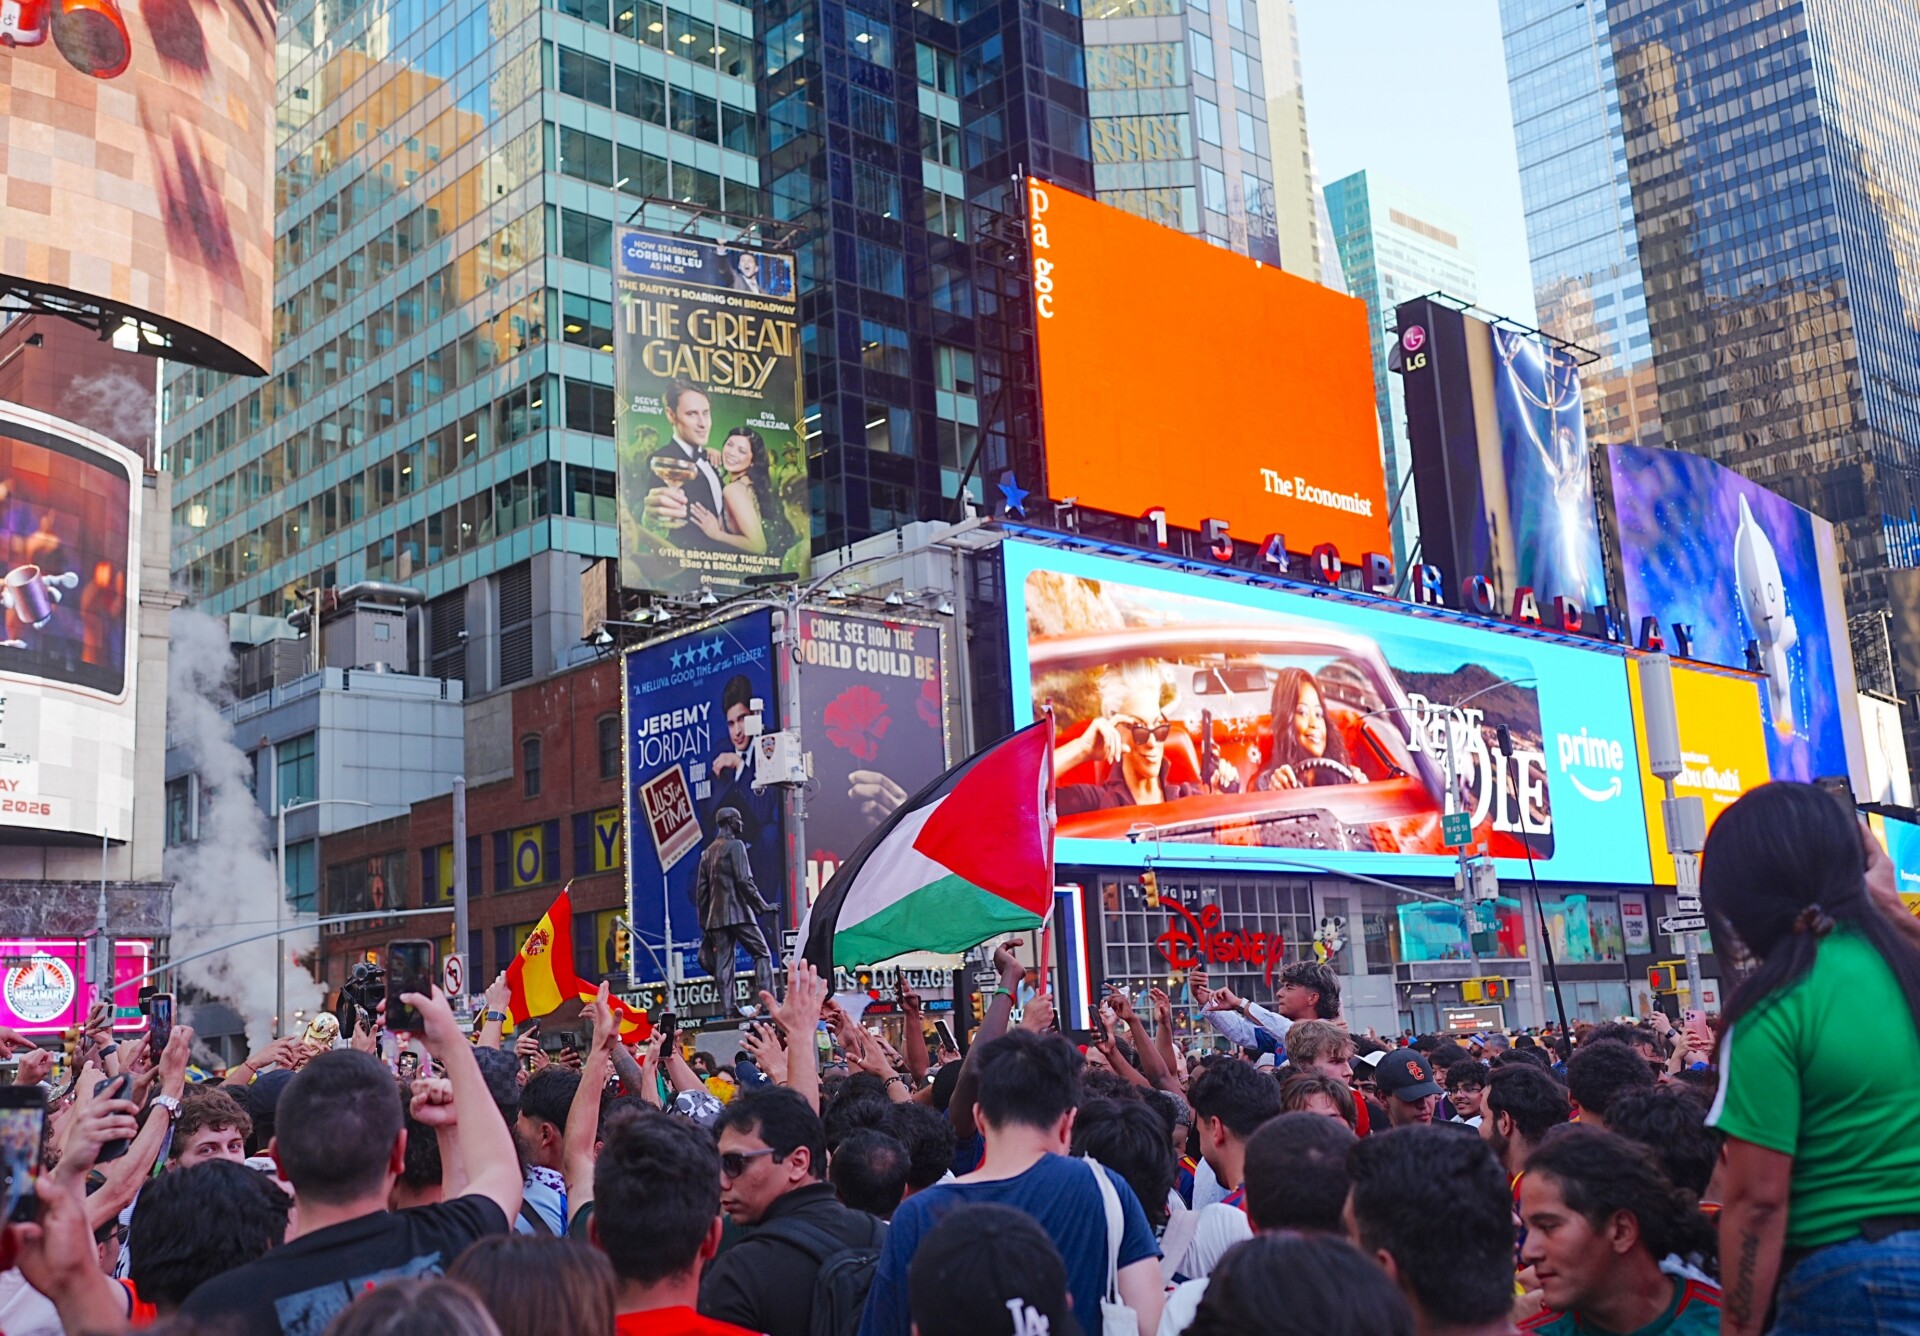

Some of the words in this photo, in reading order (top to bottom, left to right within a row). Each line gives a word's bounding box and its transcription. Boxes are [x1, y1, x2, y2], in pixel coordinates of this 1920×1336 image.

[634, 240, 656, 251] NOW
[657, 243, 699, 258] STARRING
[1030, 177, 1054, 318] pagc
[627, 248, 673, 266] CORBIN
[674, 255, 703, 269] BLEU
[650, 262, 661, 271] AS
[662, 263, 685, 275] NICK
[618, 279, 638, 291] THE
[639, 282, 680, 298] PARTY'S
[681, 288, 726, 305] ROARING
[727, 295, 743, 306] ON
[743, 299, 796, 316] BROADWAY
[622, 296, 680, 341] THE
[687, 308, 796, 357] GREAT
[642, 339, 778, 390] GATSBY
[1406, 352, 1427, 371] LG
[634, 396, 659, 407] REEVE
[707, 385, 713, 393] A
[714, 386, 731, 395] NEW
[732, 388, 763, 399] MUSICAL
[631, 404, 663, 416] CARNEY
[760, 411, 775, 421] EVA
[746, 418, 790, 431] NOBLEZADA
[1260, 467, 1293, 497] The
[1294, 476, 1373, 517] Economist
[687, 549, 738, 563] BROADWAY
[740, 554, 780, 567] THEATRE
[703, 560, 711, 570] &
[712, 562, 763, 574] BROADWAY
[1140, 506, 1342, 583] 1540
[1362, 552, 1697, 657] BROADWAY
[810, 618, 841, 642] COME
[844, 622, 865, 645] SEE
[868, 626, 891, 648] HOW
[893, 629, 915, 651] THE
[856, 647, 911, 678] COULD
[914, 655, 935, 681] BE
[641, 677, 670, 694] HELLUVA
[670, 671, 695, 684] GOOD
[696, 664, 712, 677] TIME
[638, 701, 711, 738] JEREMY
[638, 723, 711, 770] JORDAN
[1557, 726, 1624, 773] prime
[1702, 766, 1741, 792] dhabi
[650, 782, 675, 817] JUST
[1440, 745, 1552, 834] DIE
[2, 799, 51, 816] 2026
[1452, 825, 1461, 833] 45
[1625, 920, 1644, 929] COMING
[1629, 929, 1642, 937] SOON
[1666, 921, 1681, 929] ONE
[1687, 919, 1703, 928] WAY
[871, 969, 954, 989] LUGAGE
[15, 989, 64, 1001] MEGAMART
[674, 980, 750, 1007] UGGAE
[678, 1019, 702, 1029] SONY
[1407, 1061, 1424, 1080] SC
[1005, 1298, 1049, 1336] LA
